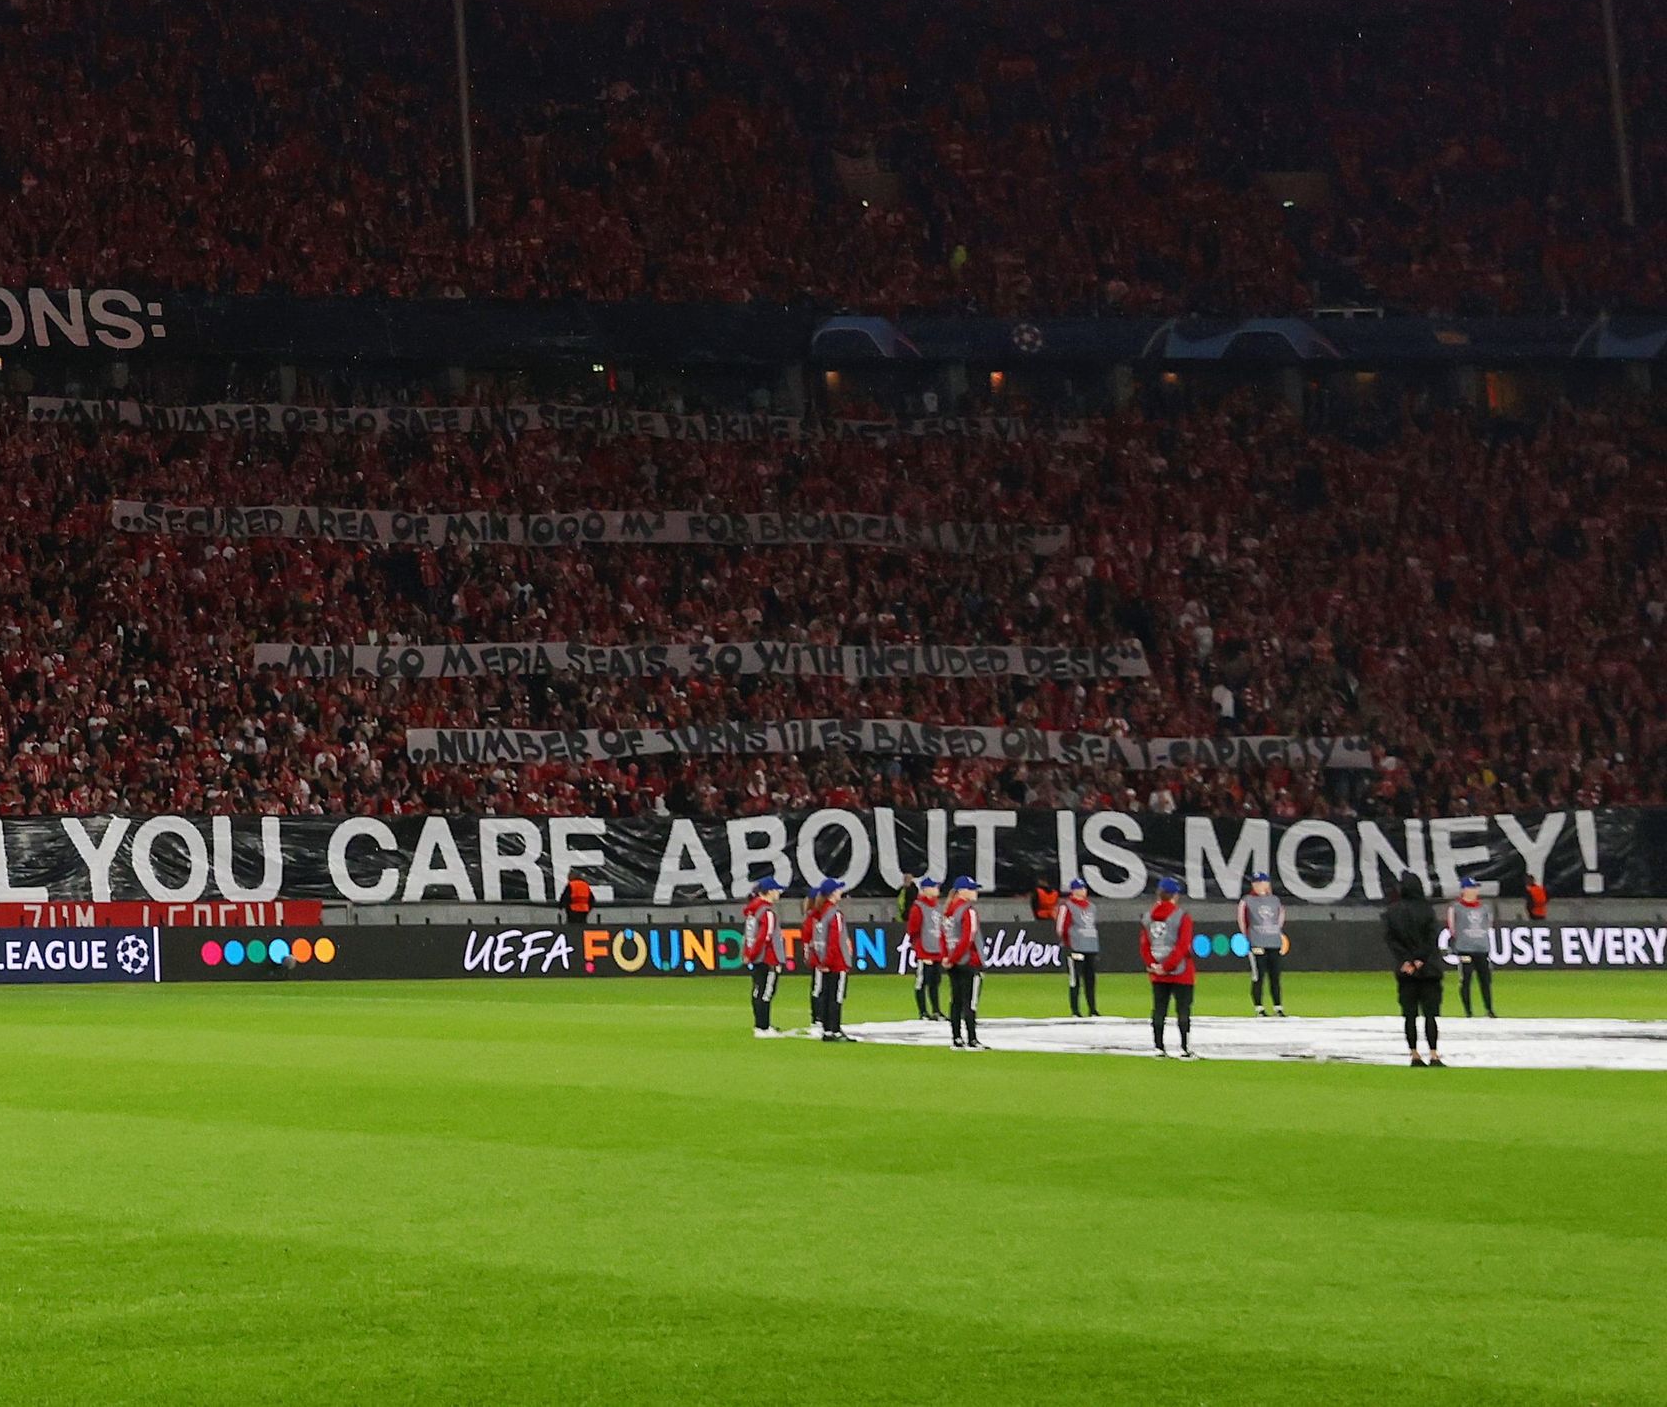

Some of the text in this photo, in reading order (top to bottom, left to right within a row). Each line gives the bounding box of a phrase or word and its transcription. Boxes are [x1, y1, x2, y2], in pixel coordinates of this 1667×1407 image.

[281, 409, 318, 432] OF
[295, 508, 379, 542] AREA
[392, 513, 431, 543] OF
[520, 512, 606, 545] 1000
[687, 513, 749, 544] FOR
[376, 645, 425, 677] 60
[440, 644, 554, 677] MEDIA
[688, 644, 743, 675] 30
[754, 642, 845, 676] WITH
[855, 645, 1009, 677] INCLUDED
[597, 728, 647, 757] OF
[870, 722, 988, 758] BASED
[1001, 728, 1050, 762] ON
[62, 815, 284, 905] YOU
[327, 815, 616, 905] CARE
[652, 805, 1022, 905] ABOUT
[1059, 808, 1151, 900] IS
[1184, 808, 1604, 906] MONEY!
[463, 929, 574, 973] UEFA
[583, 928, 885, 974] FOUNDTN
[1560, 927, 1667, 965] EVERY
